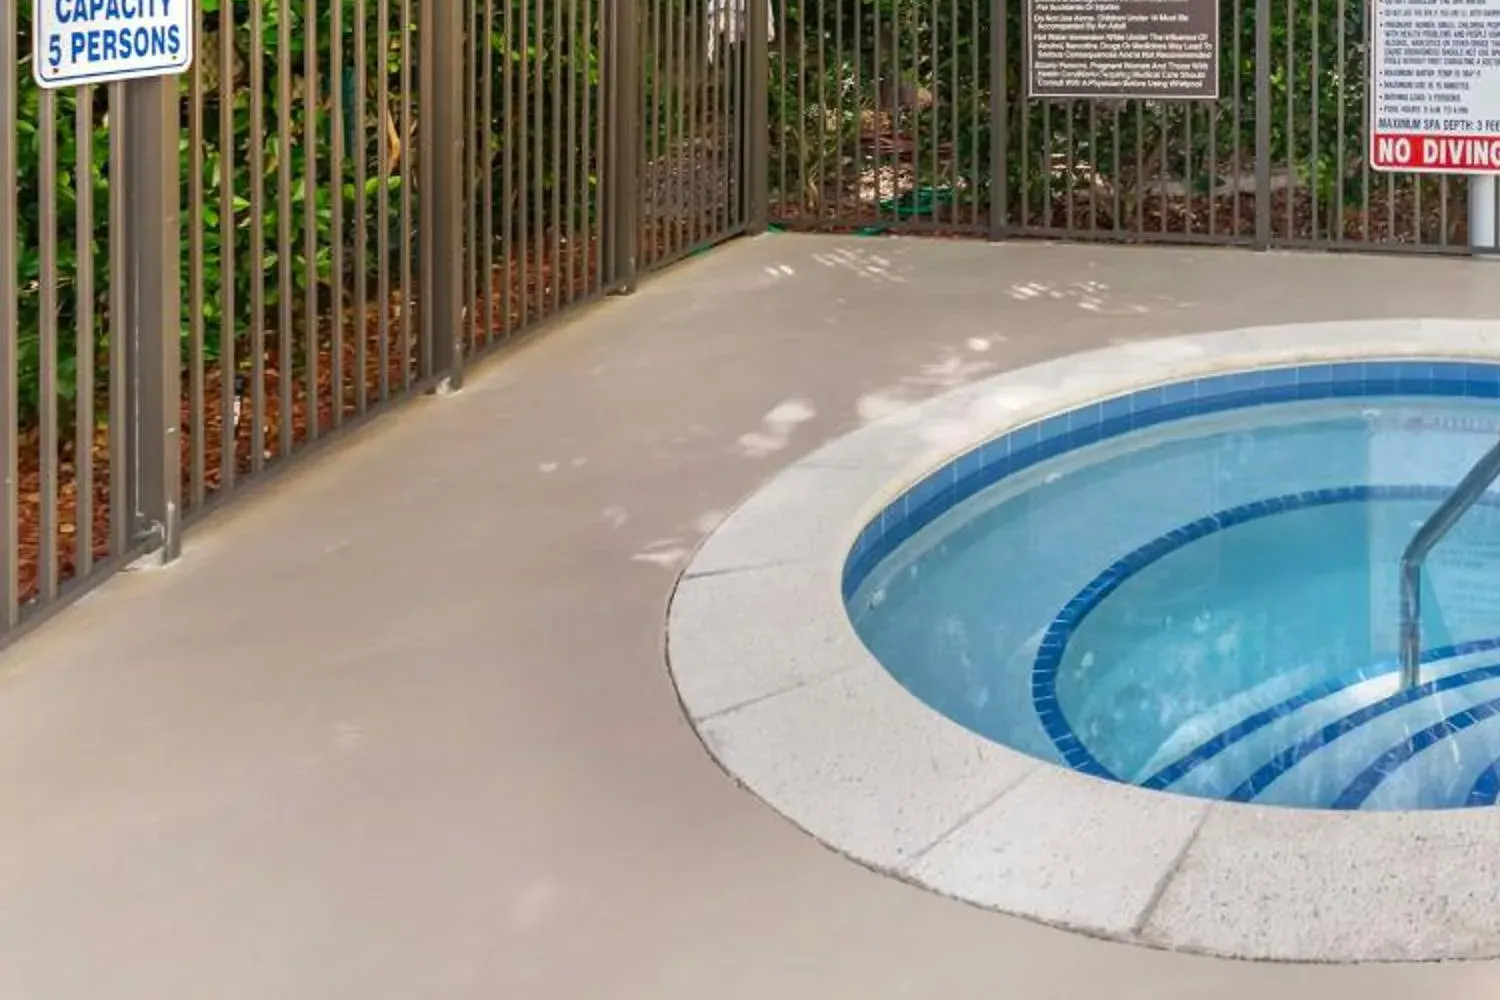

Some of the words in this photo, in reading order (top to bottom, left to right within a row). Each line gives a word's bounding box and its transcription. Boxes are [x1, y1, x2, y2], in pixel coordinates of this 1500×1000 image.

[49, 34, 62, 66] 5
[71, 24, 180, 63] PERSONS
[1379, 118, 1421, 129] MAXIMUM
[1423, 119, 1440, 130] SPA
[1443, 119, 1474, 131] DEPTH:
[1379, 137, 1411, 163] NO
